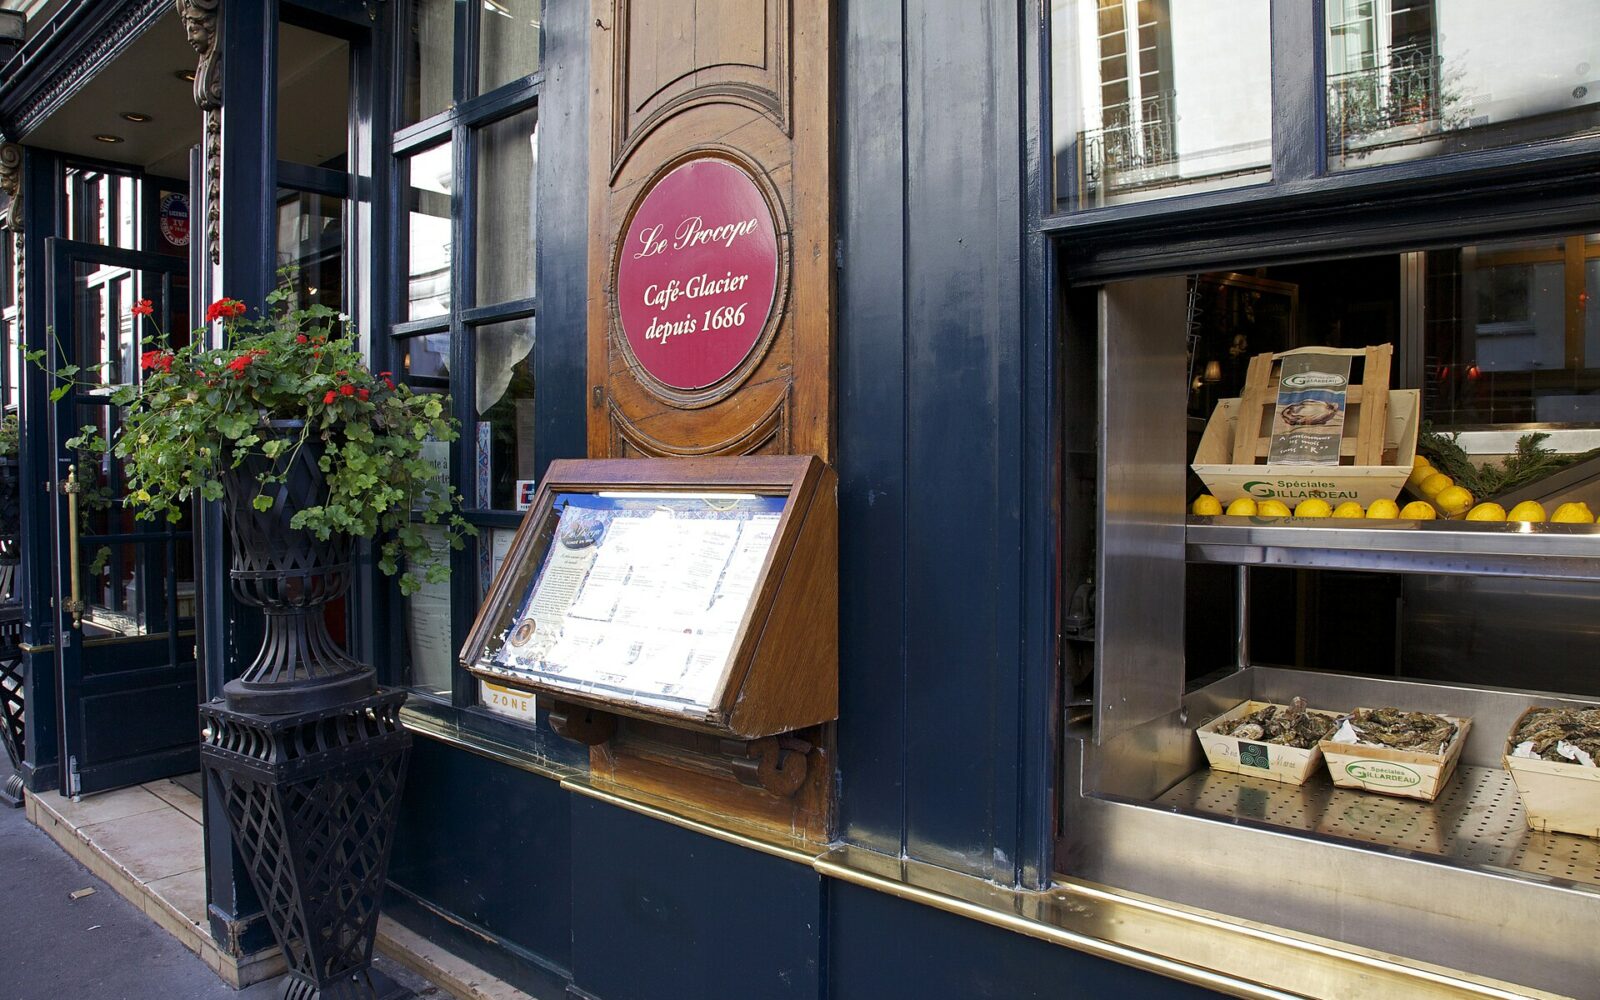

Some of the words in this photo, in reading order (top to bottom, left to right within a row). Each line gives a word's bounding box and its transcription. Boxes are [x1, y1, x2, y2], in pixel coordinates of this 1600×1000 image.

[634, 224, 667, 260] Le
[674, 216, 758, 249] Procope
[644, 272, 749, 310] Café-Glacier
[645, 314, 697, 344] depuis
[702, 302, 748, 332] 1686
[1278, 480, 1336, 489] Spéciales
[492, 694, 527, 711] ZONE
[1370, 766, 1405, 775] Spéciales
